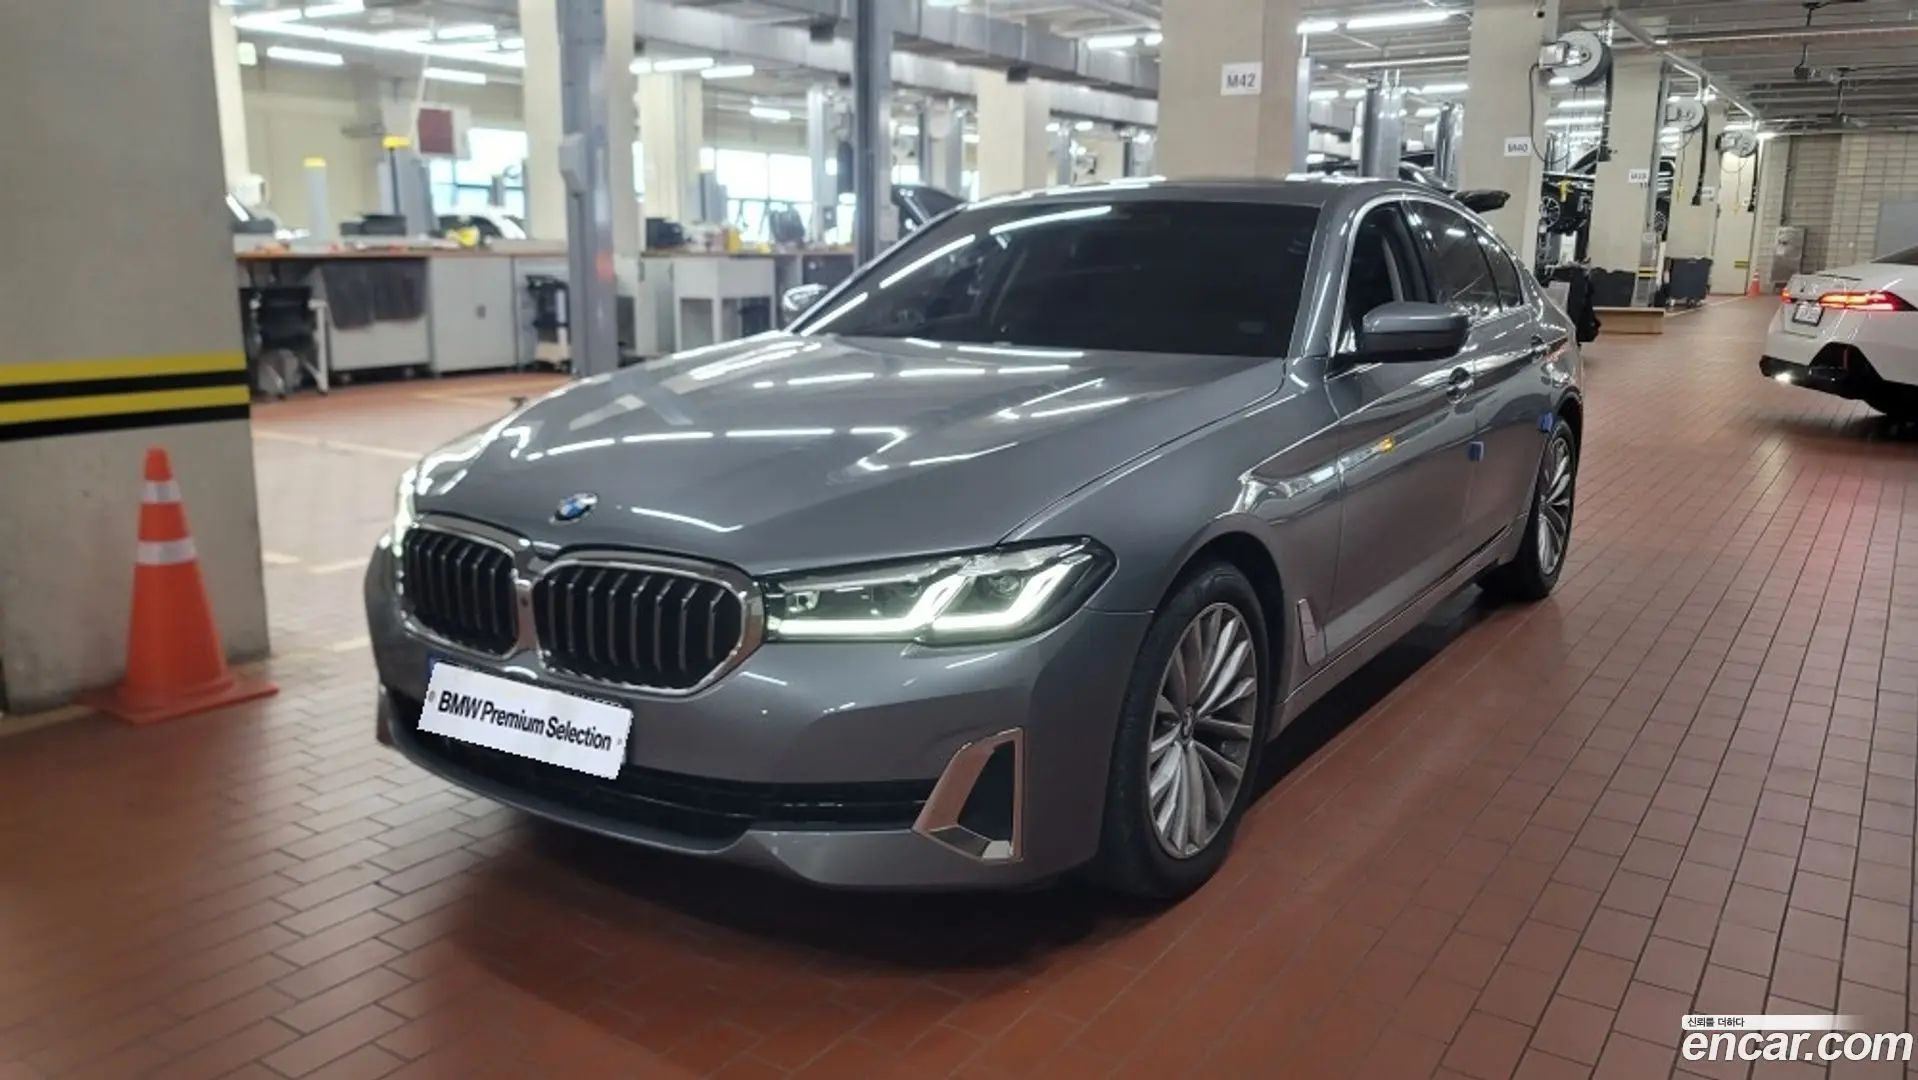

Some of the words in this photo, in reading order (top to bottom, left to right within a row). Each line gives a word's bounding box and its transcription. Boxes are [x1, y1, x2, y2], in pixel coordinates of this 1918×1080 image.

[1226, 73, 1256, 88] M42
[438, 690, 482, 721] BMW
[480, 702, 545, 735] Premium
[545, 716, 612, 751] Selection
